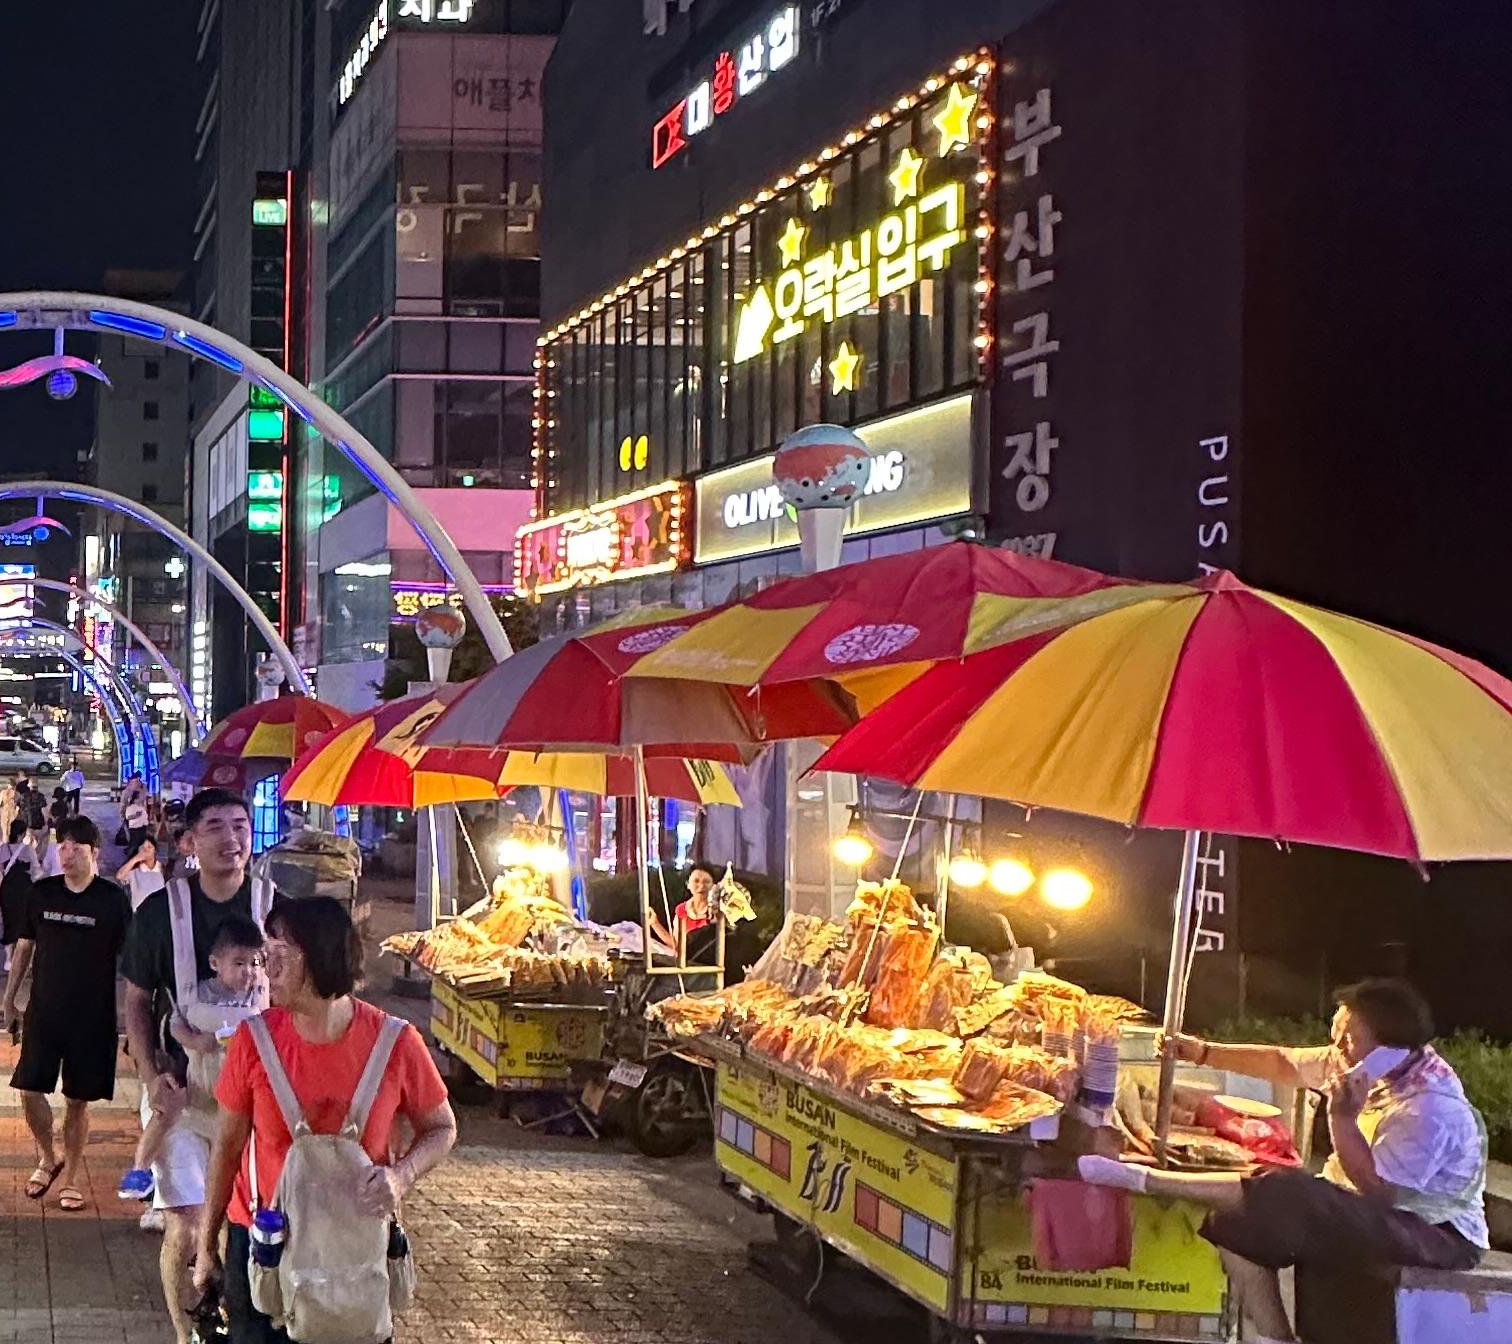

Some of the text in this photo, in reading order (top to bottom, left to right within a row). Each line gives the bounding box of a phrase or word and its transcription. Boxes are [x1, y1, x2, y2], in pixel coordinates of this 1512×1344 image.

[1002, 87, 1063, 513] 부산극장
[786, 1089, 836, 1130] BUSAN
[1015, 1272, 1191, 1294] International Film Festival
